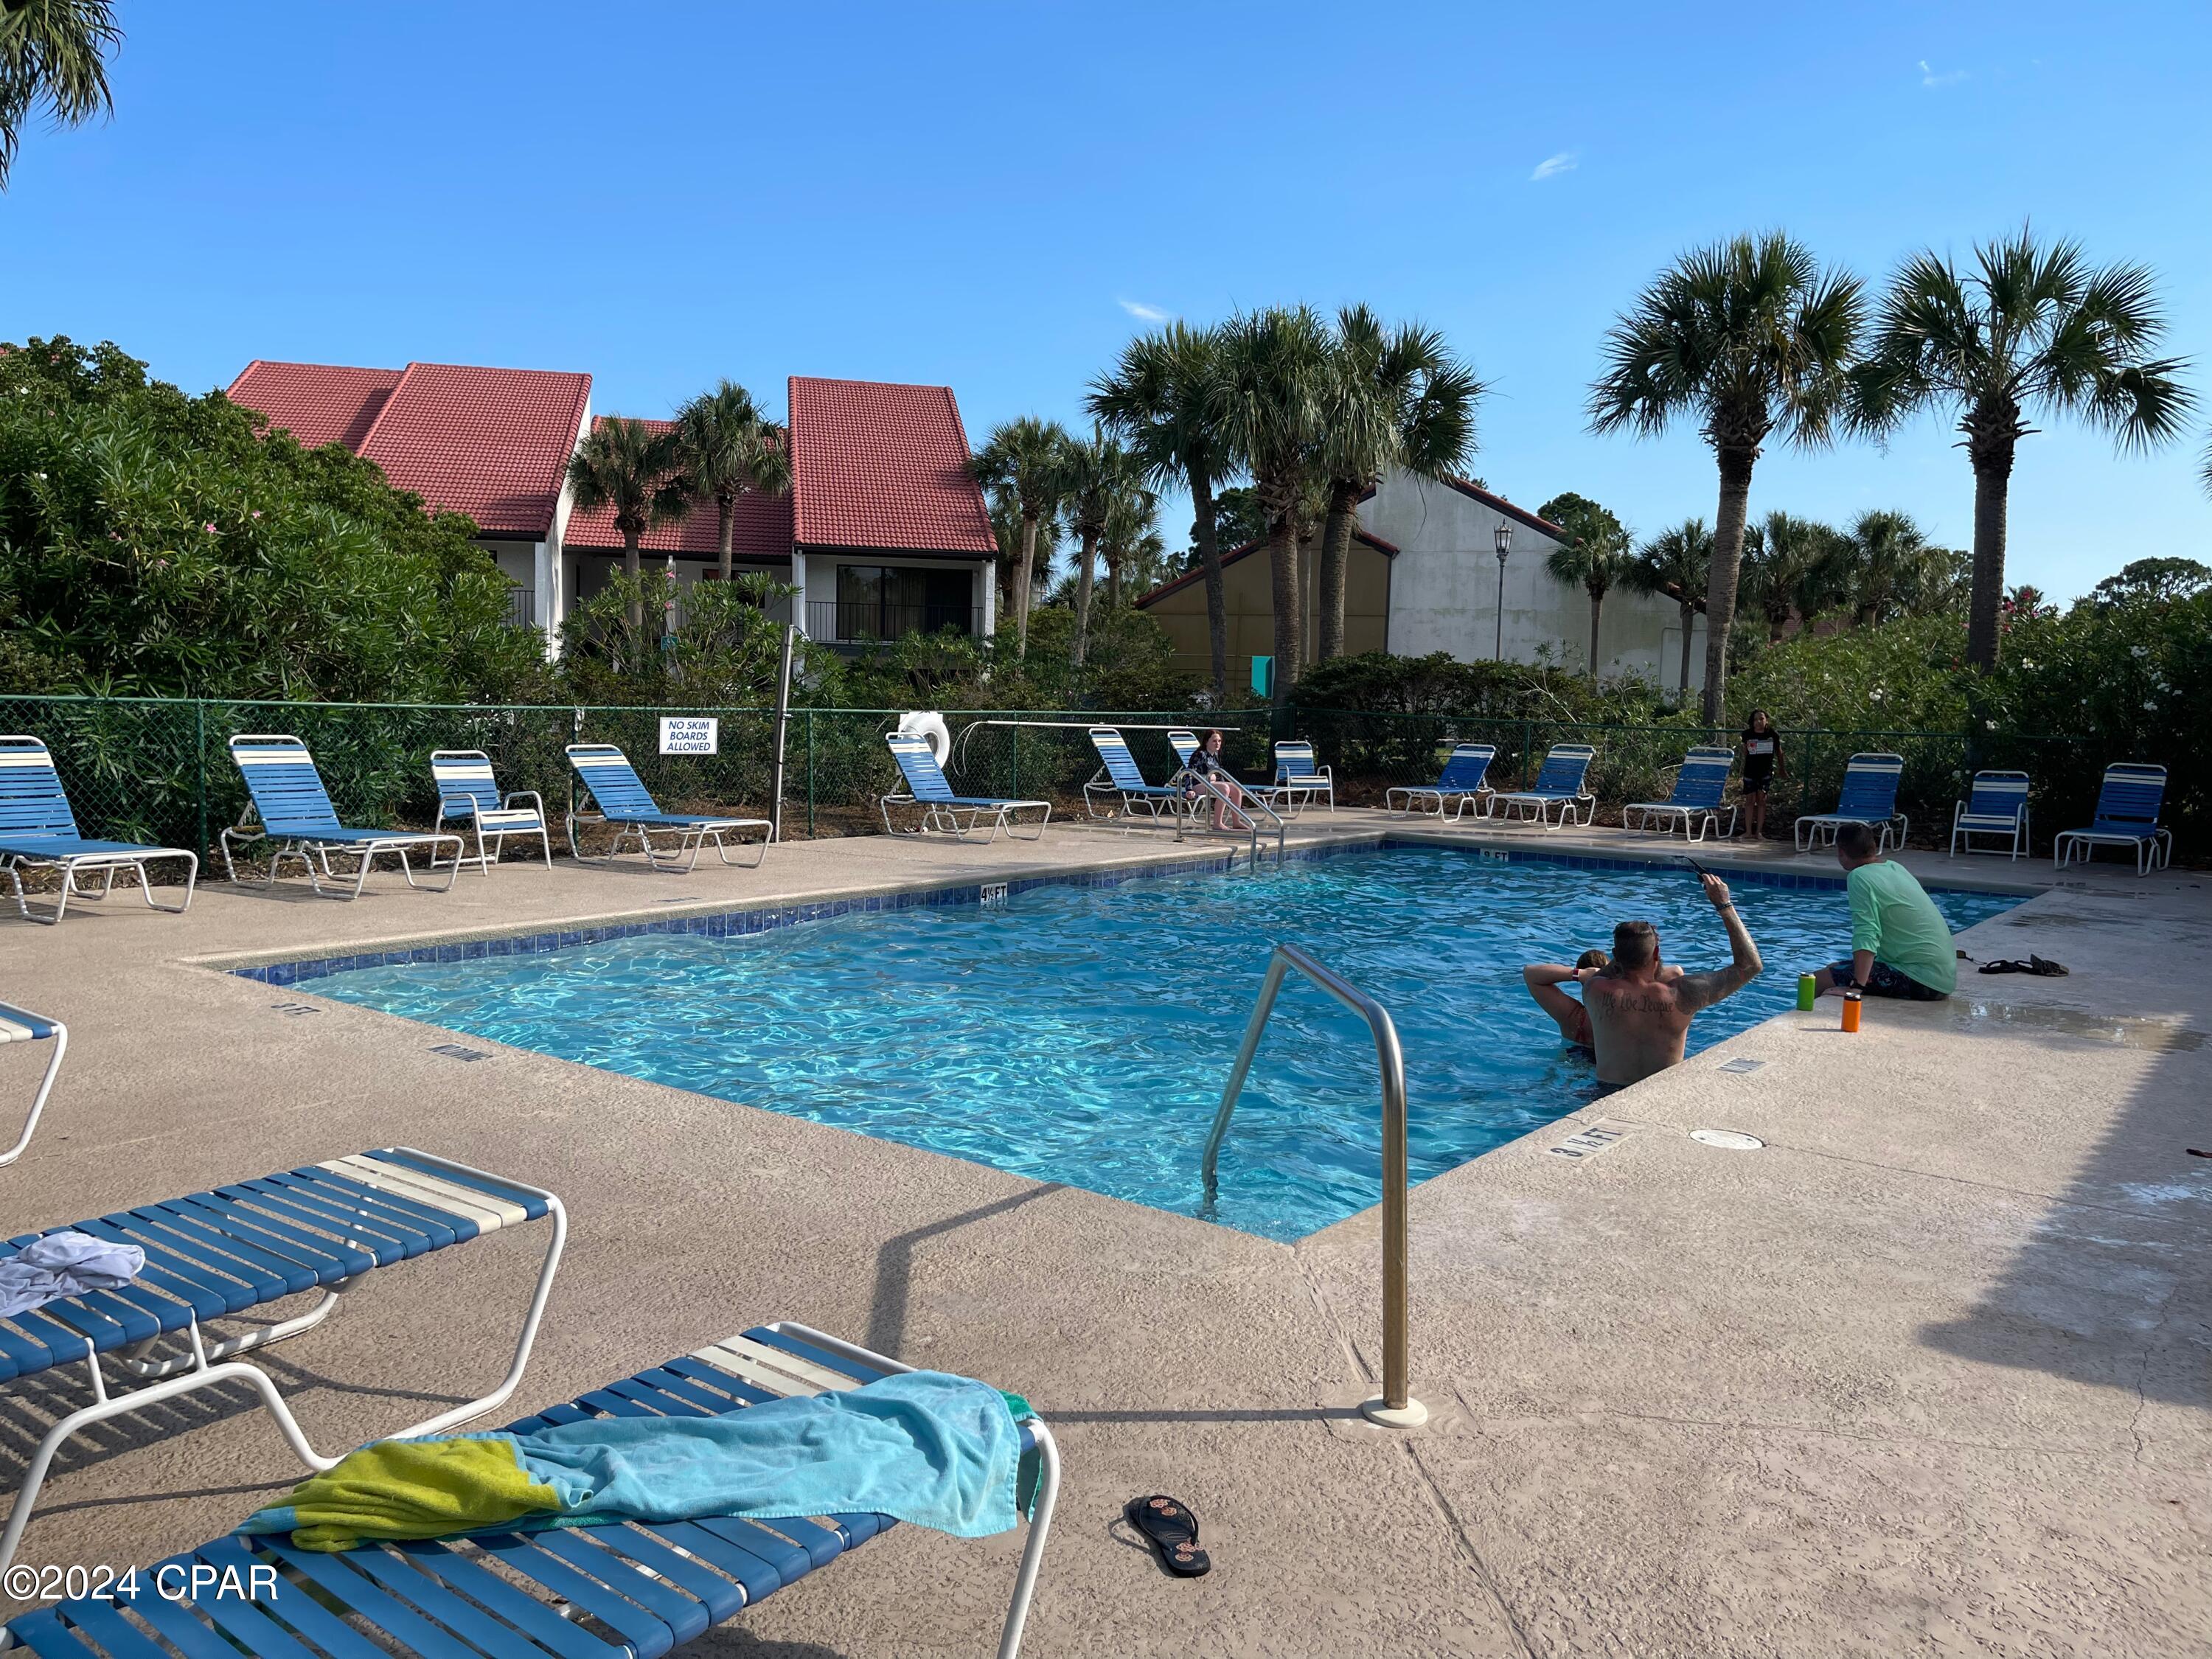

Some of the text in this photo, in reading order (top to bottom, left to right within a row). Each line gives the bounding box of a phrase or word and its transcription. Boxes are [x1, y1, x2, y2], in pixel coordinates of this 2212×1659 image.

[669, 721, 709, 730] NO SKIM
[669, 731, 708, 740] BOARDS
[667, 742, 711, 751] ALLOWED
[995, 886, 1006, 899] FT
[1550, 1147, 1584, 1158] 3
